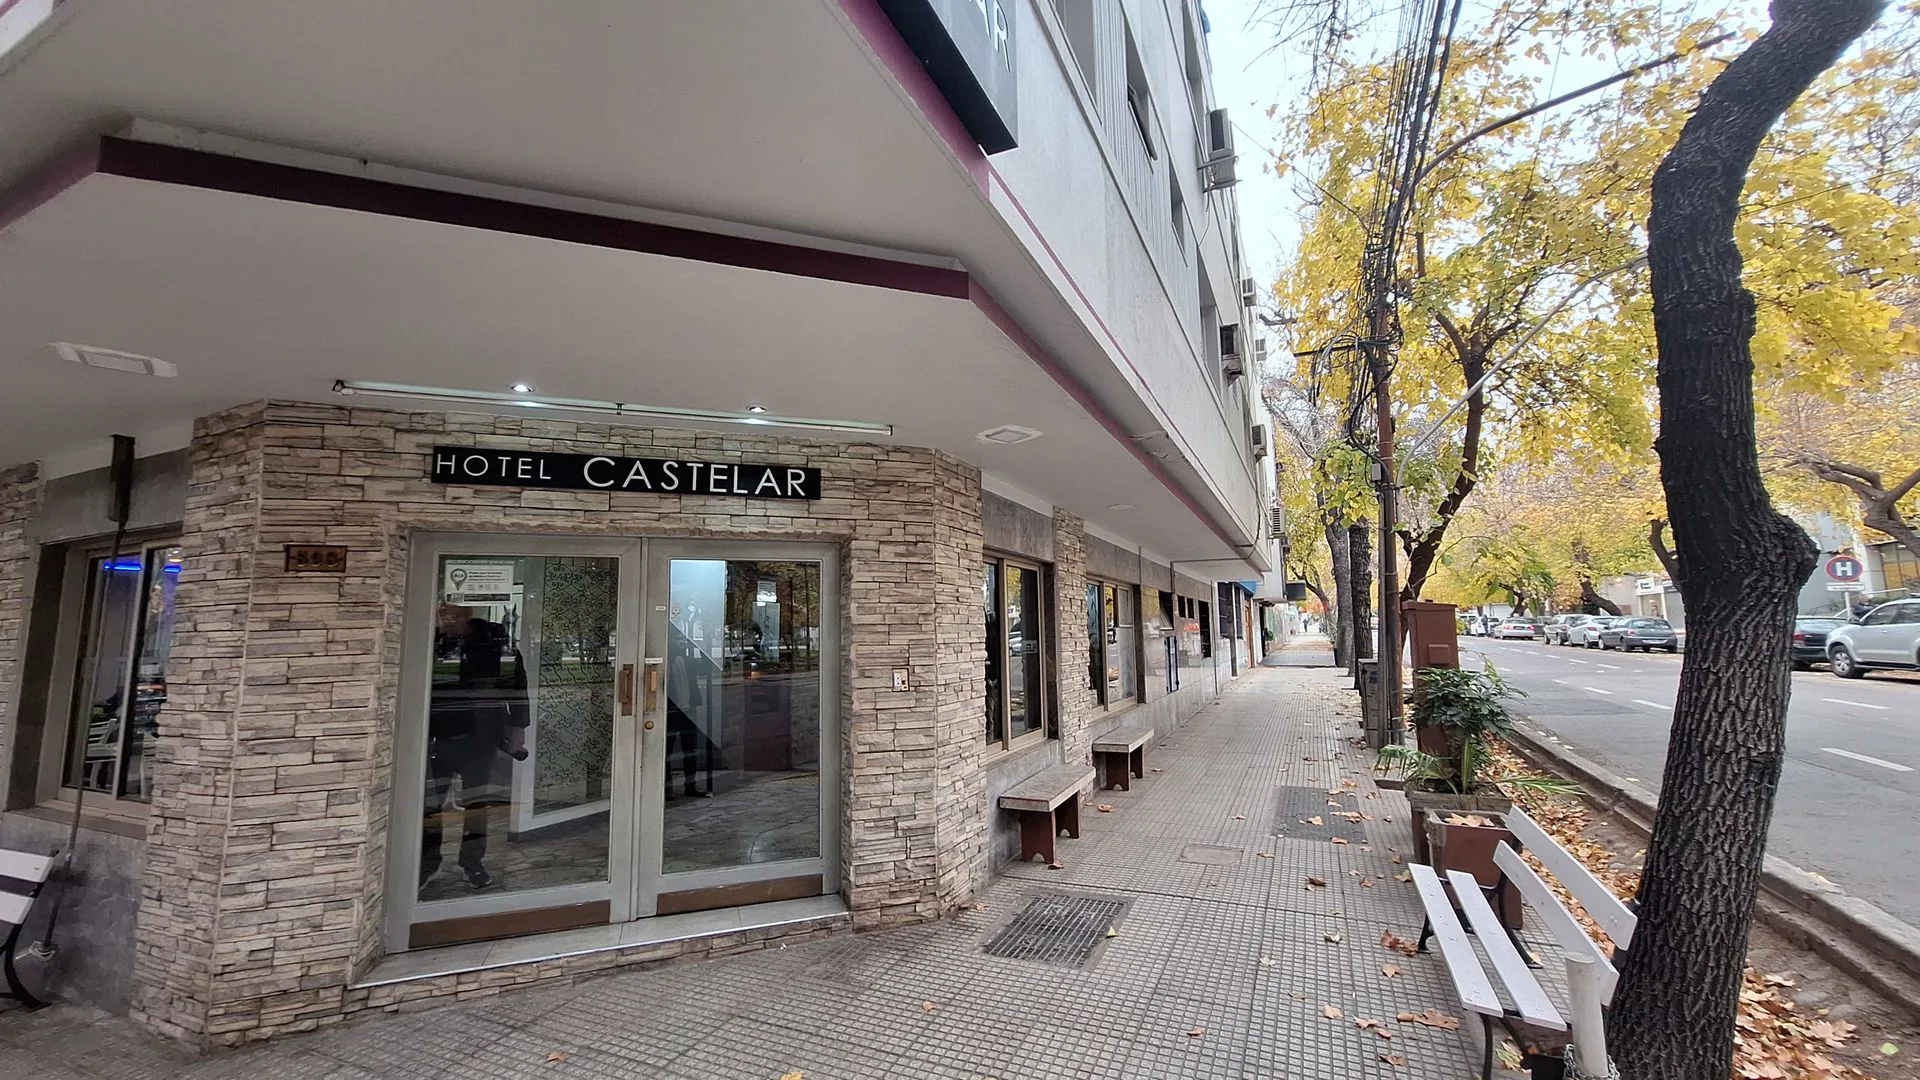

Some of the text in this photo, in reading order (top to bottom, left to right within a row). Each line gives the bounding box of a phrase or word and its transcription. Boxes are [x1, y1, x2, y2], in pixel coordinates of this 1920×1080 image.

[436, 453, 807, 497] HOTEL CASTELAR
[1835, 561, 1853, 577] H
